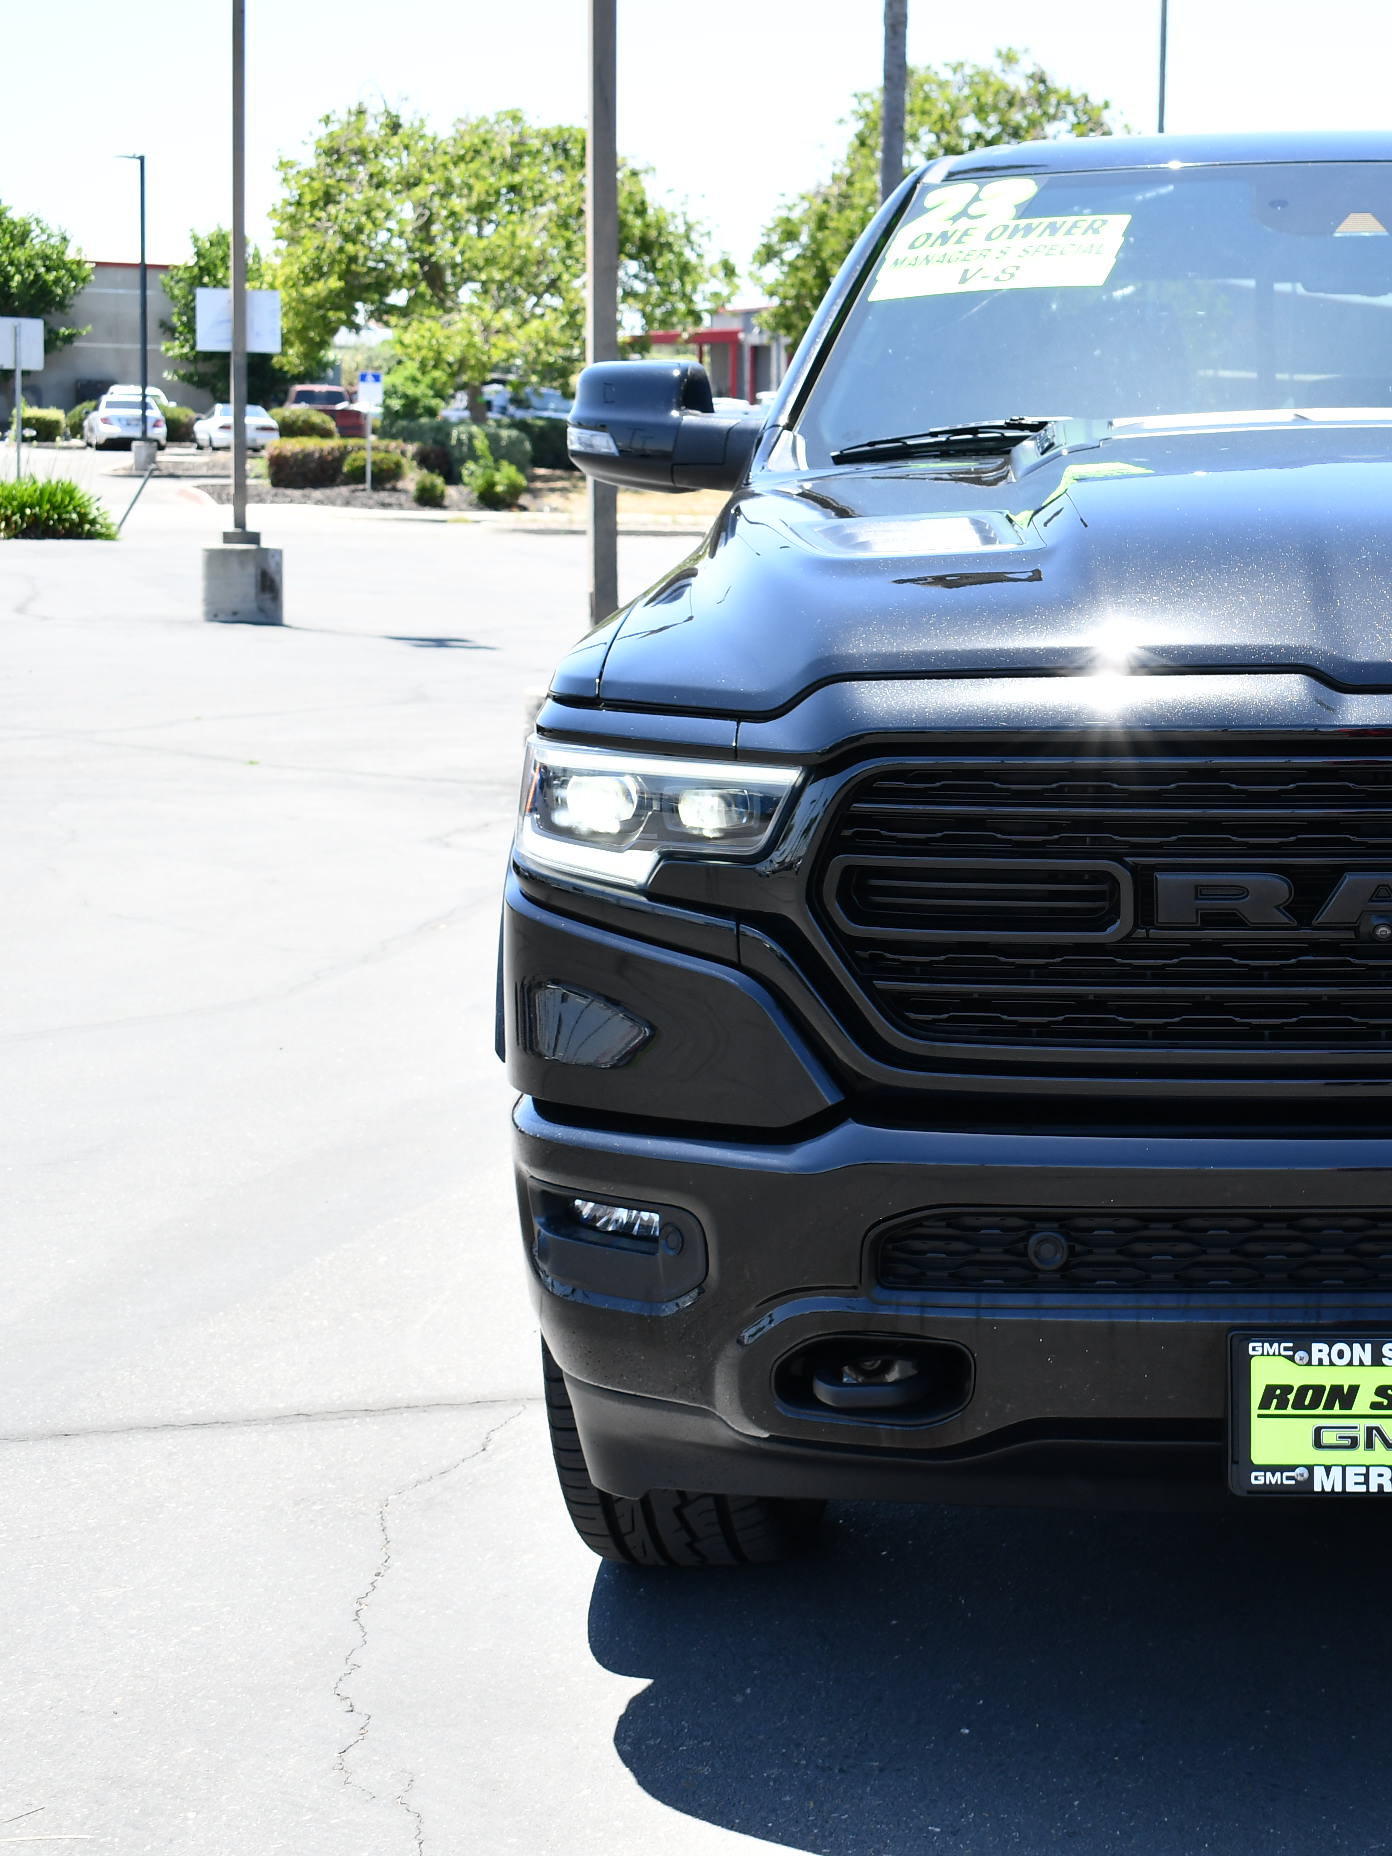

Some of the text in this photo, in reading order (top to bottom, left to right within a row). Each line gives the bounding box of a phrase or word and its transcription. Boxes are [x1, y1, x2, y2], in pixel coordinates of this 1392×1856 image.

[907, 218, 1108, 251] ONE OWNER
[1248, 1342, 1294, 1356] GMC
[1311, 1342, 1372, 1366] RON
[1257, 1384, 1360, 1411] RON
[1250, 1471, 1296, 1485] GMC
